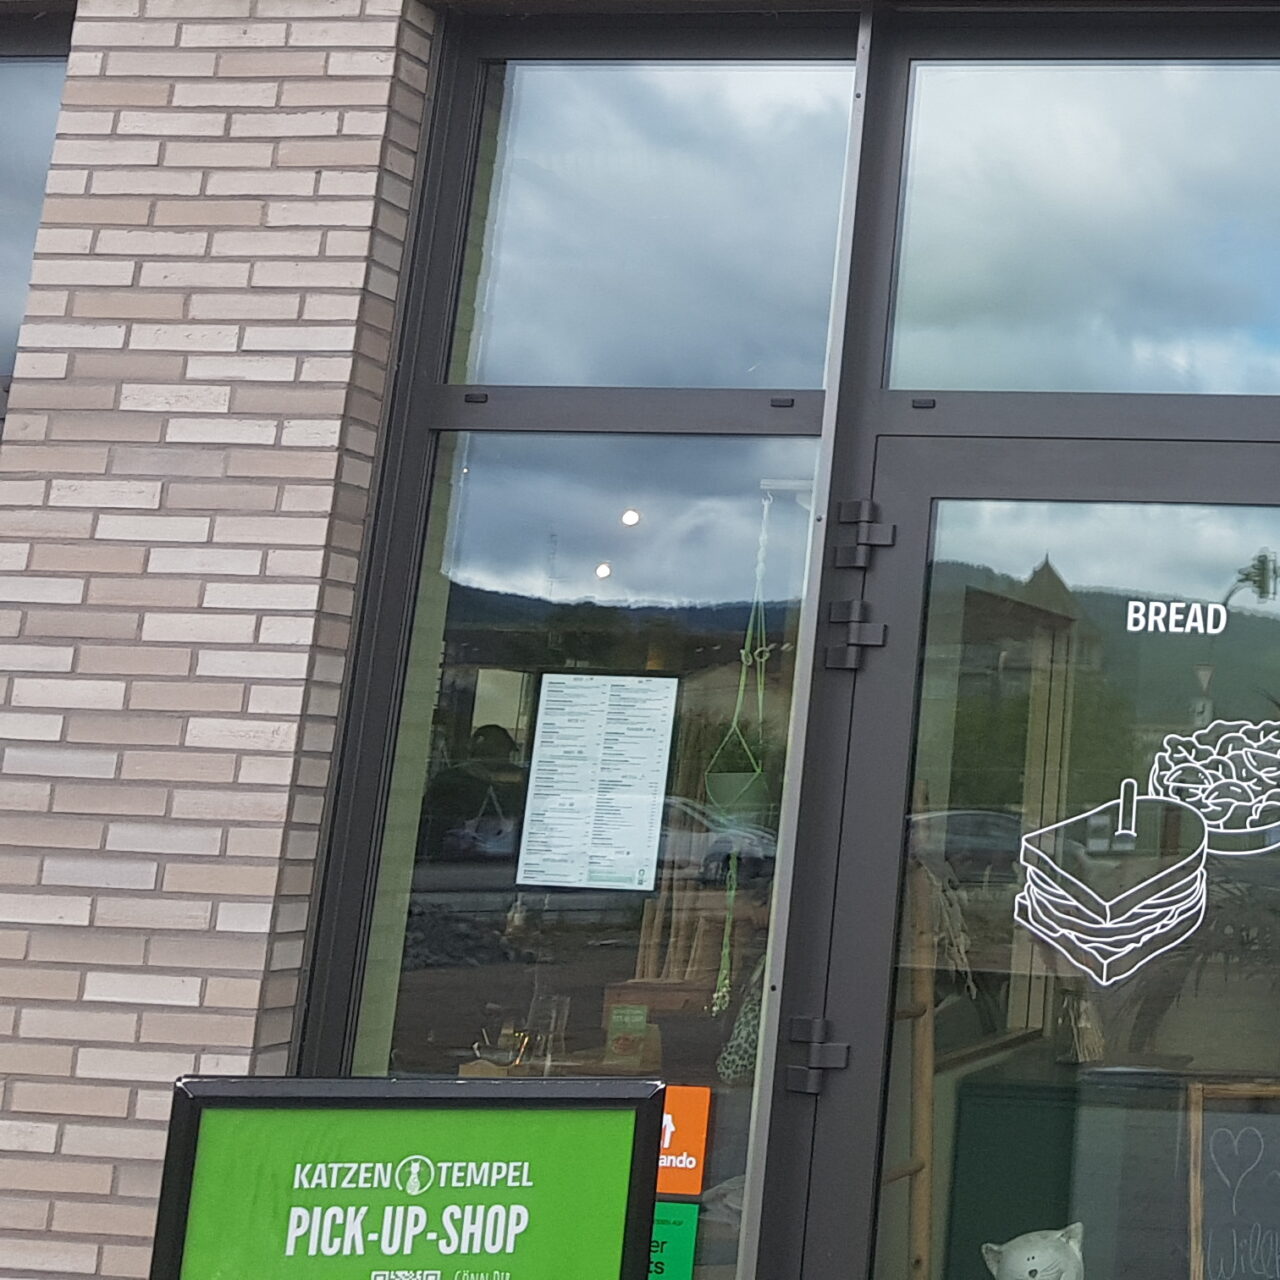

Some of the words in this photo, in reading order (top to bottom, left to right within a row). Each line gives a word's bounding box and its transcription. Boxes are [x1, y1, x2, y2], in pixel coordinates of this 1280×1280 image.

[1126, 600, 1228, 635] BREAD
[293, 1162, 393, 1190] KATZEN
[437, 1161, 534, 1188] TEMPEL
[285, 1204, 529, 1257] PICK-UP-SHOP
